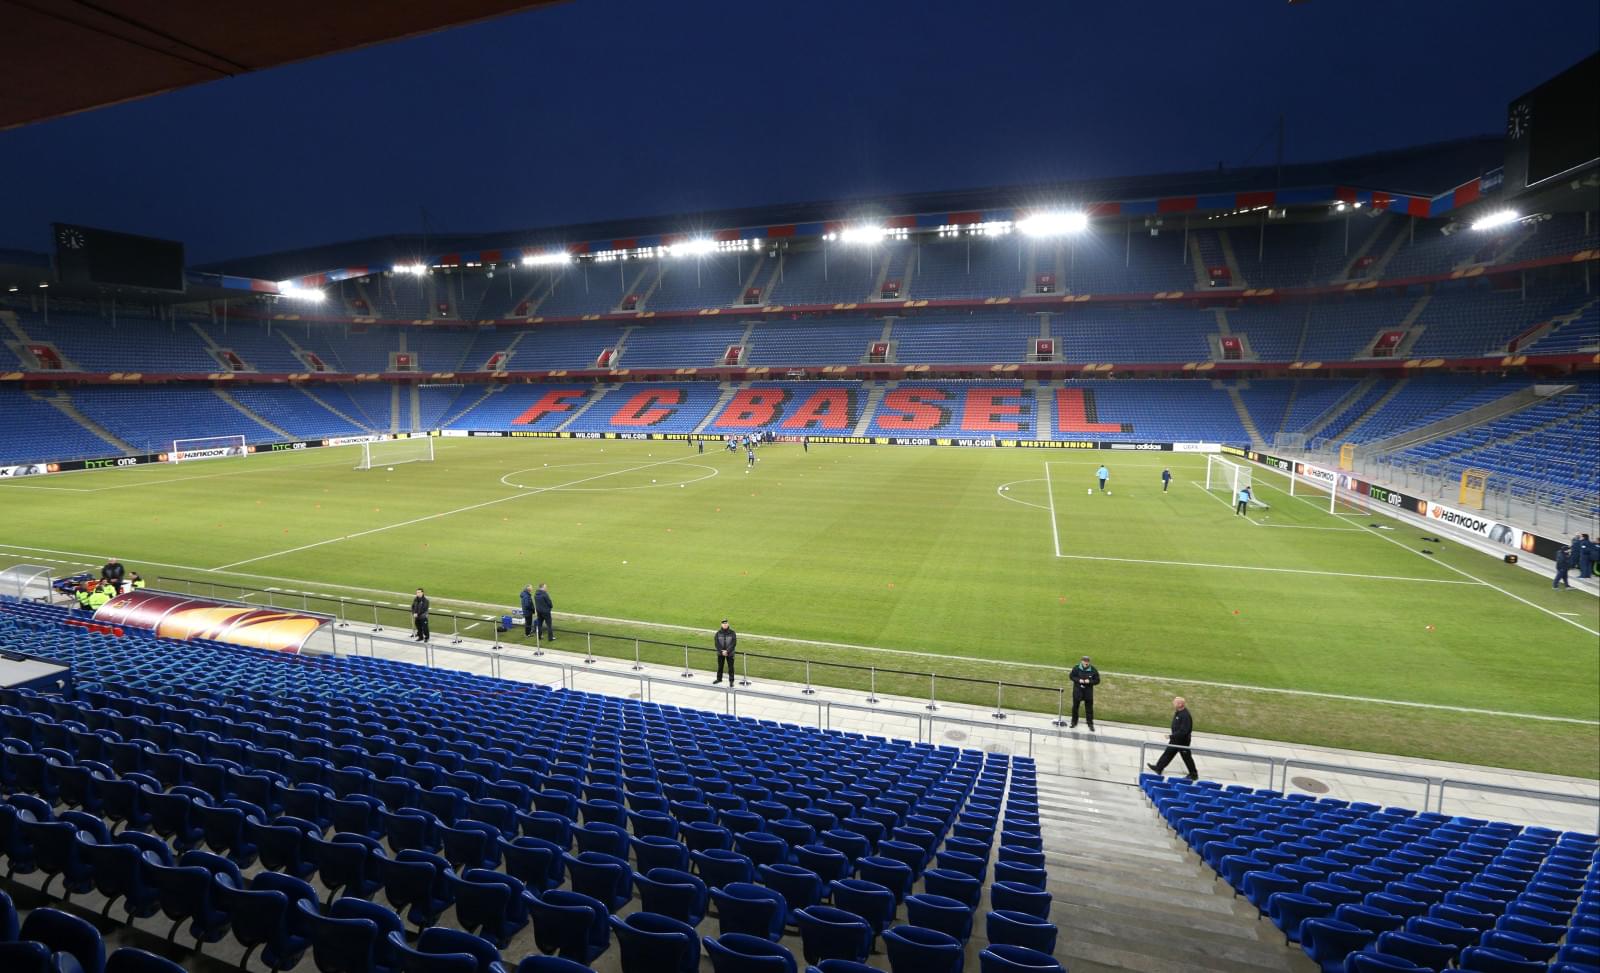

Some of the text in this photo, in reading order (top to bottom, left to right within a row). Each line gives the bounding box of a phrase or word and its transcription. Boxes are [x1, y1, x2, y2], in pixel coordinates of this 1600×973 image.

[715, 387, 1133, 432] BASEL
[958, 439, 994, 447] wu.com
[1021, 440, 1094, 449] WESTERN UNION
[117, 457, 137, 466] one
